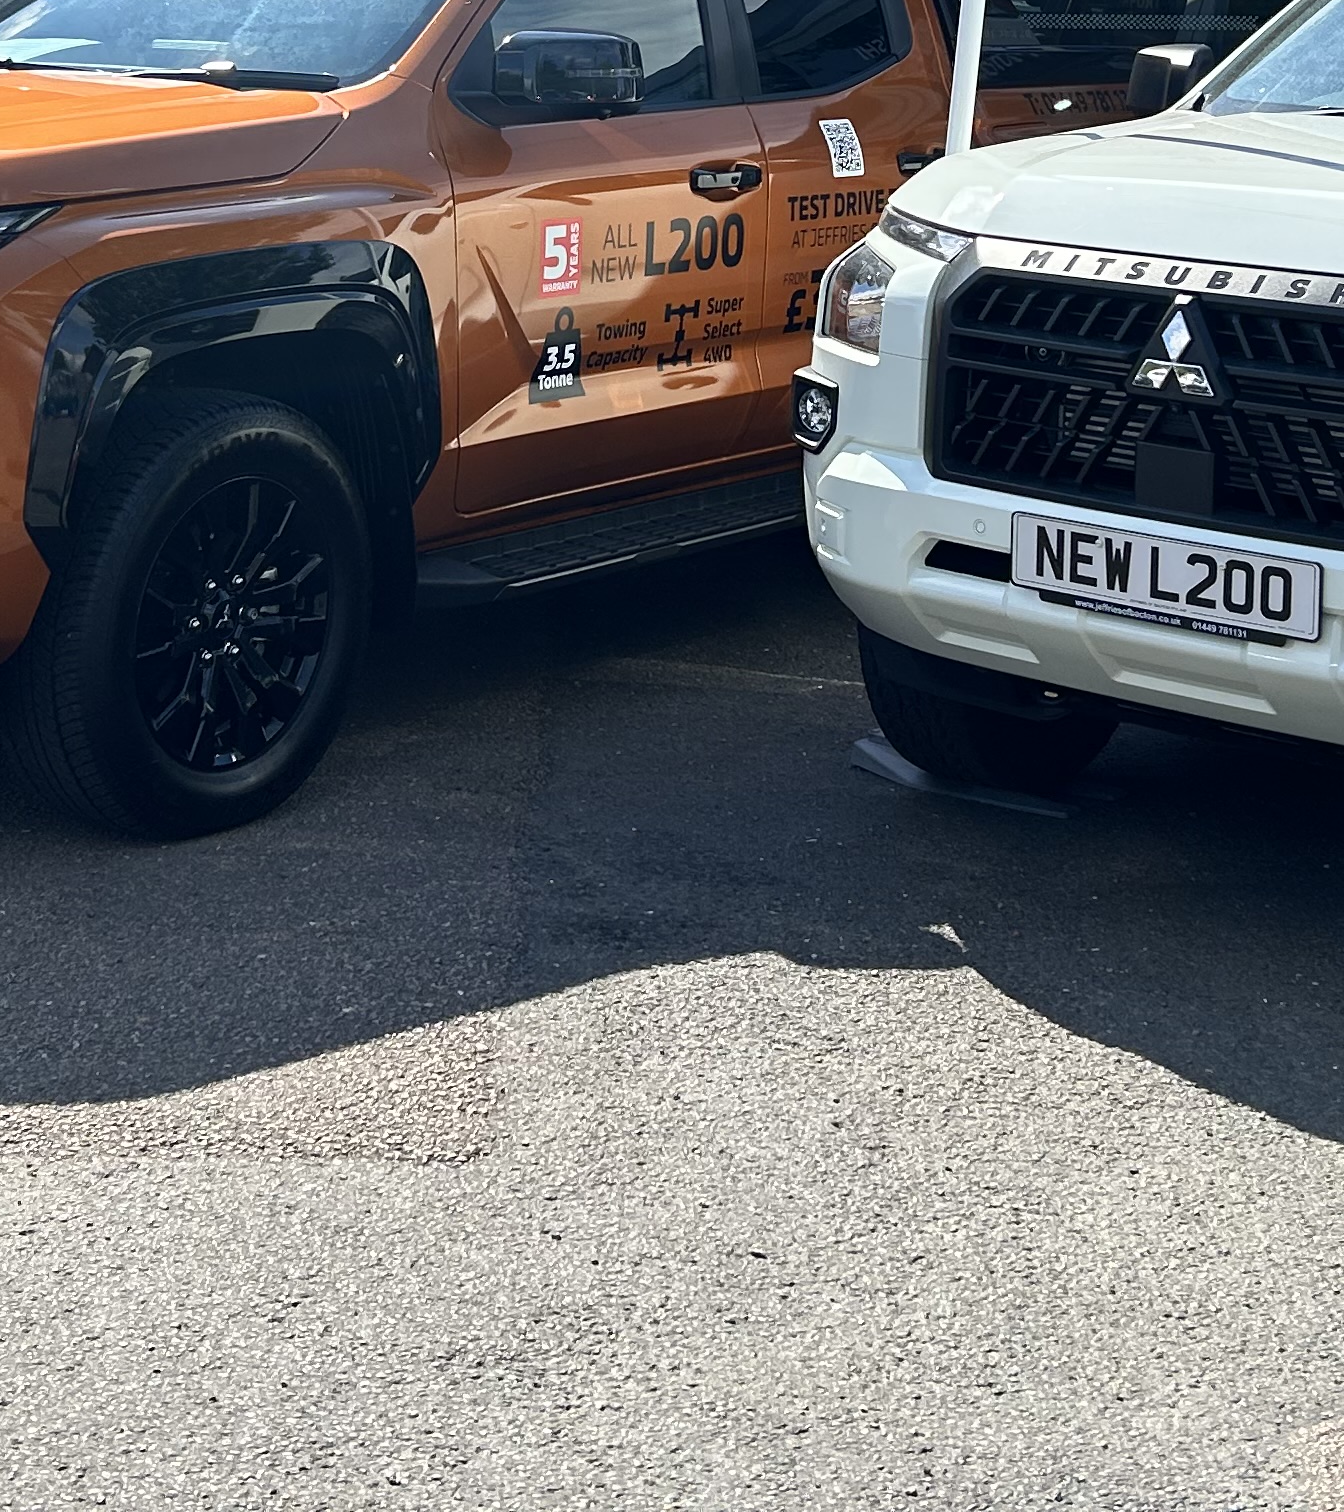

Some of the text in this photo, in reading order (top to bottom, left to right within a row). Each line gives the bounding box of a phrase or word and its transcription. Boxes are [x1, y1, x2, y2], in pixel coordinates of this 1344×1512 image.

[788, 189, 885, 222] TEST DRIVE
[590, 213, 745, 285] NEW L200
[602, 223, 638, 250] ALL
[791, 229, 808, 249] AT
[809, 223, 867, 248] JEFFRIES
[543, 222, 580, 280] 5 YEARS
[706, 296, 744, 317] Super
[596, 319, 647, 342] Towing
[703, 319, 742, 340] Select
[543, 343, 577, 372] 3.5
[586, 344, 649, 371] Capacity
[703, 344, 732, 364] 4WD
[538, 372, 573, 391] Tonne
[1035, 525, 1292, 622] NEW L200
[1192, 620, 1217, 635] 01449
